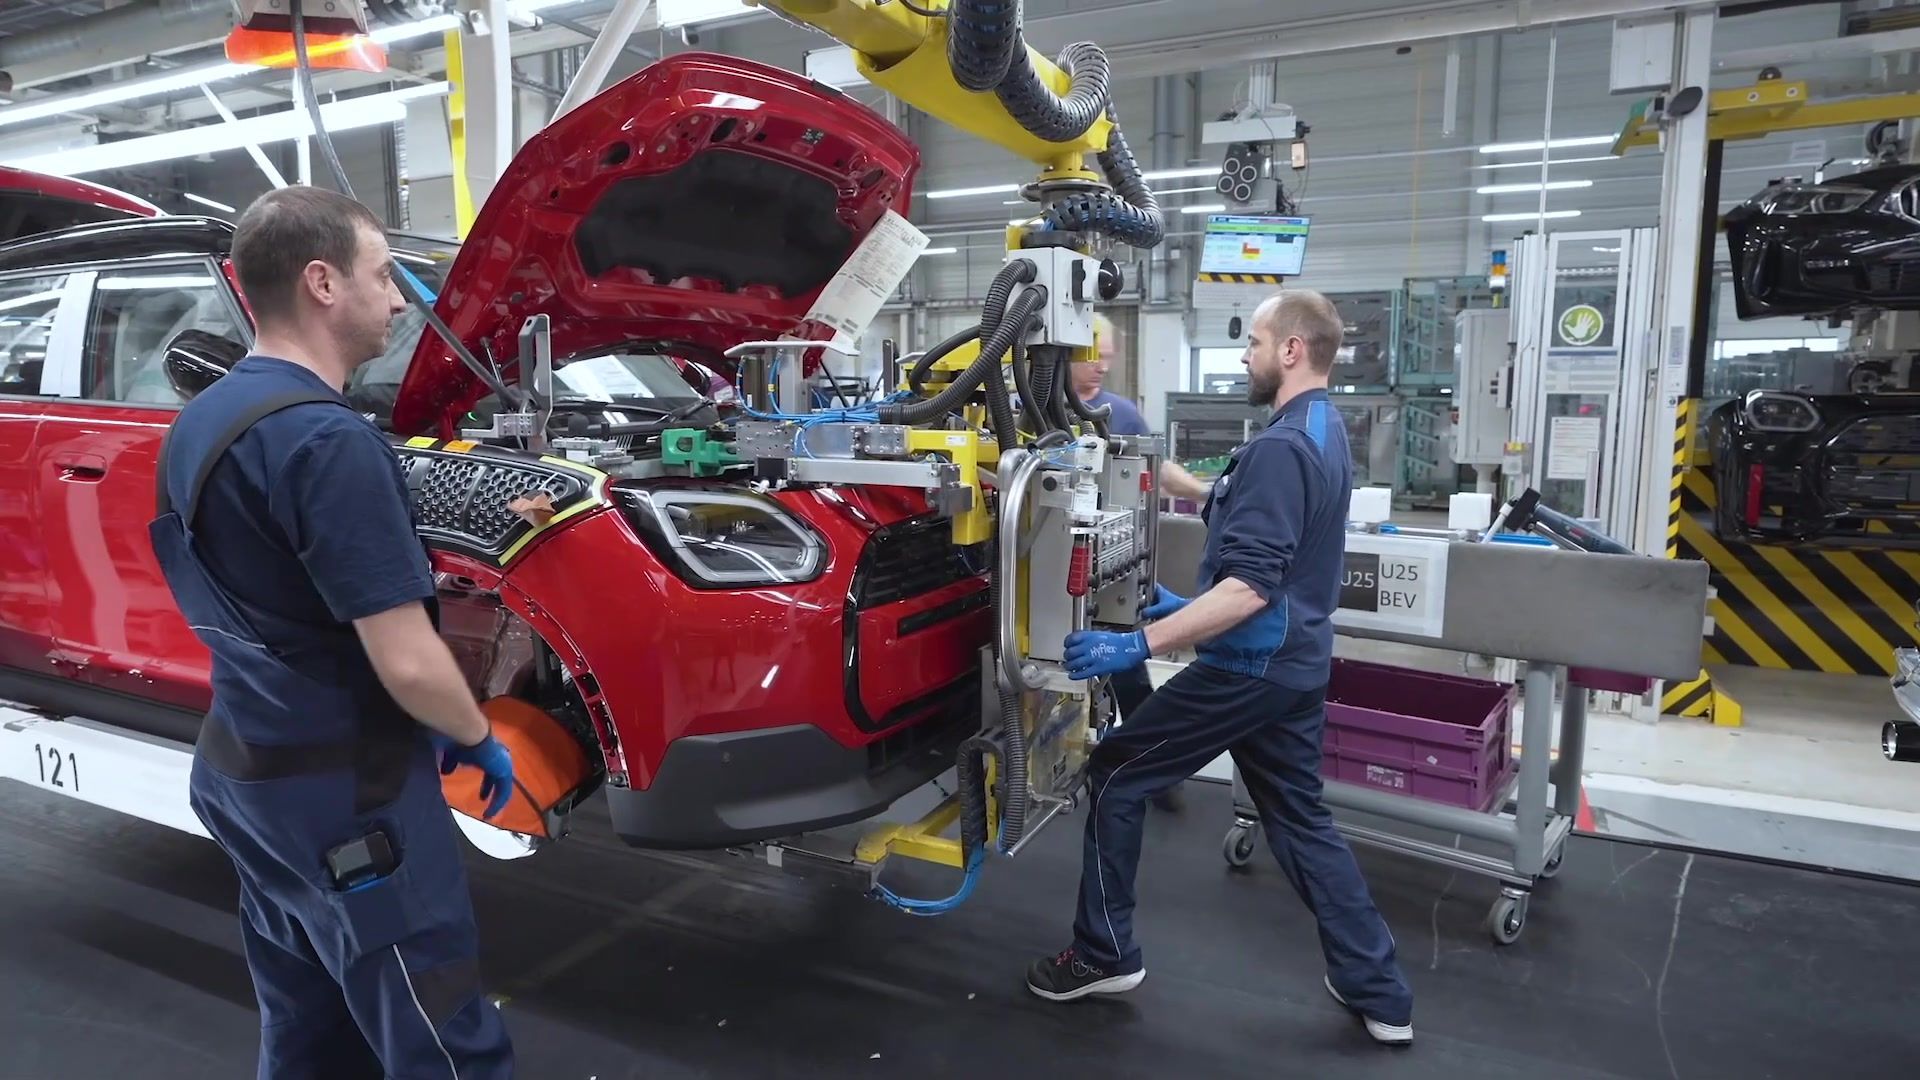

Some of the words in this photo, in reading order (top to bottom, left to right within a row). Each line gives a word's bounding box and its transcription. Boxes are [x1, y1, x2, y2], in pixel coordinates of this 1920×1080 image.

[1341, 571, 1375, 588] U25
[1381, 563, 1418, 581] U25
[1380, 590, 1417, 609] BEV
[35, 743, 79, 792] 121
